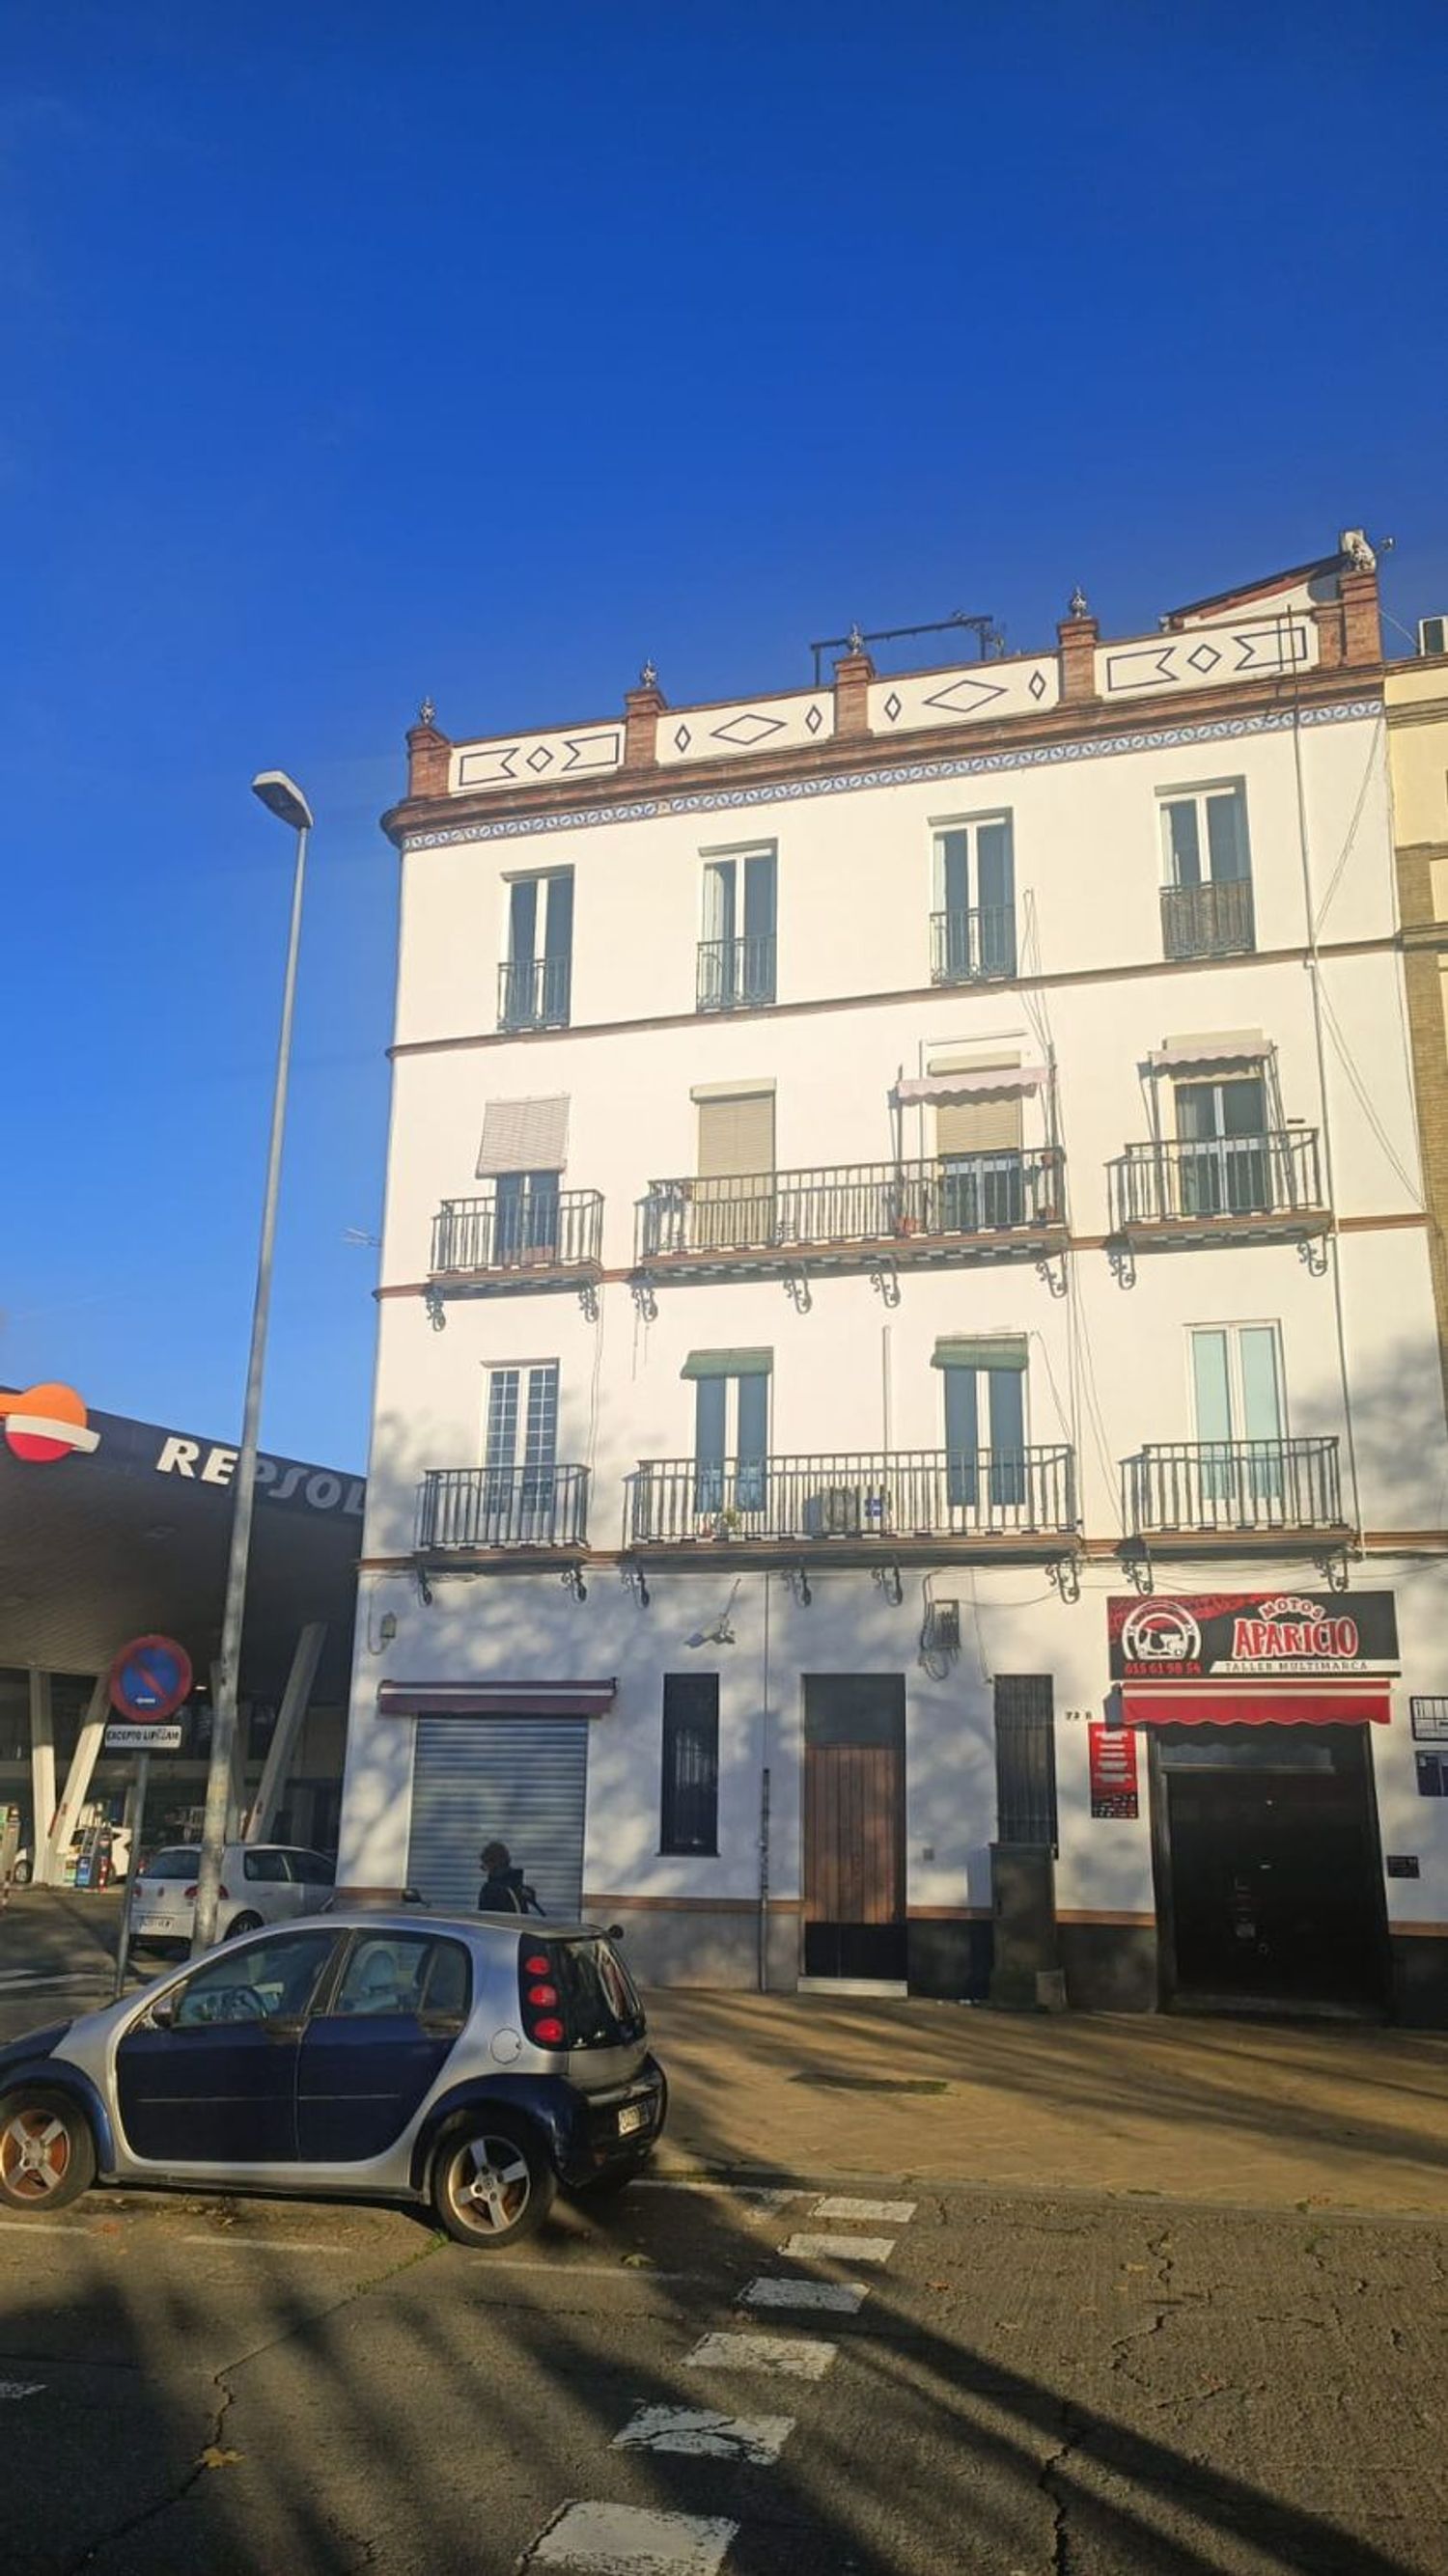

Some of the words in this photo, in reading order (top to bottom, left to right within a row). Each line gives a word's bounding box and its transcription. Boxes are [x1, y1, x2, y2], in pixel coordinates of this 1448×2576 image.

[156, 1436, 367, 1515] REPSOL
[1260, 1597, 1324, 1620] MOTOS
[1233, 1618, 1358, 1658] APARICIO
[1226, 1662, 1272, 1672] TALLER
[1278, 1661, 1368, 1672] MULTIMARCA
